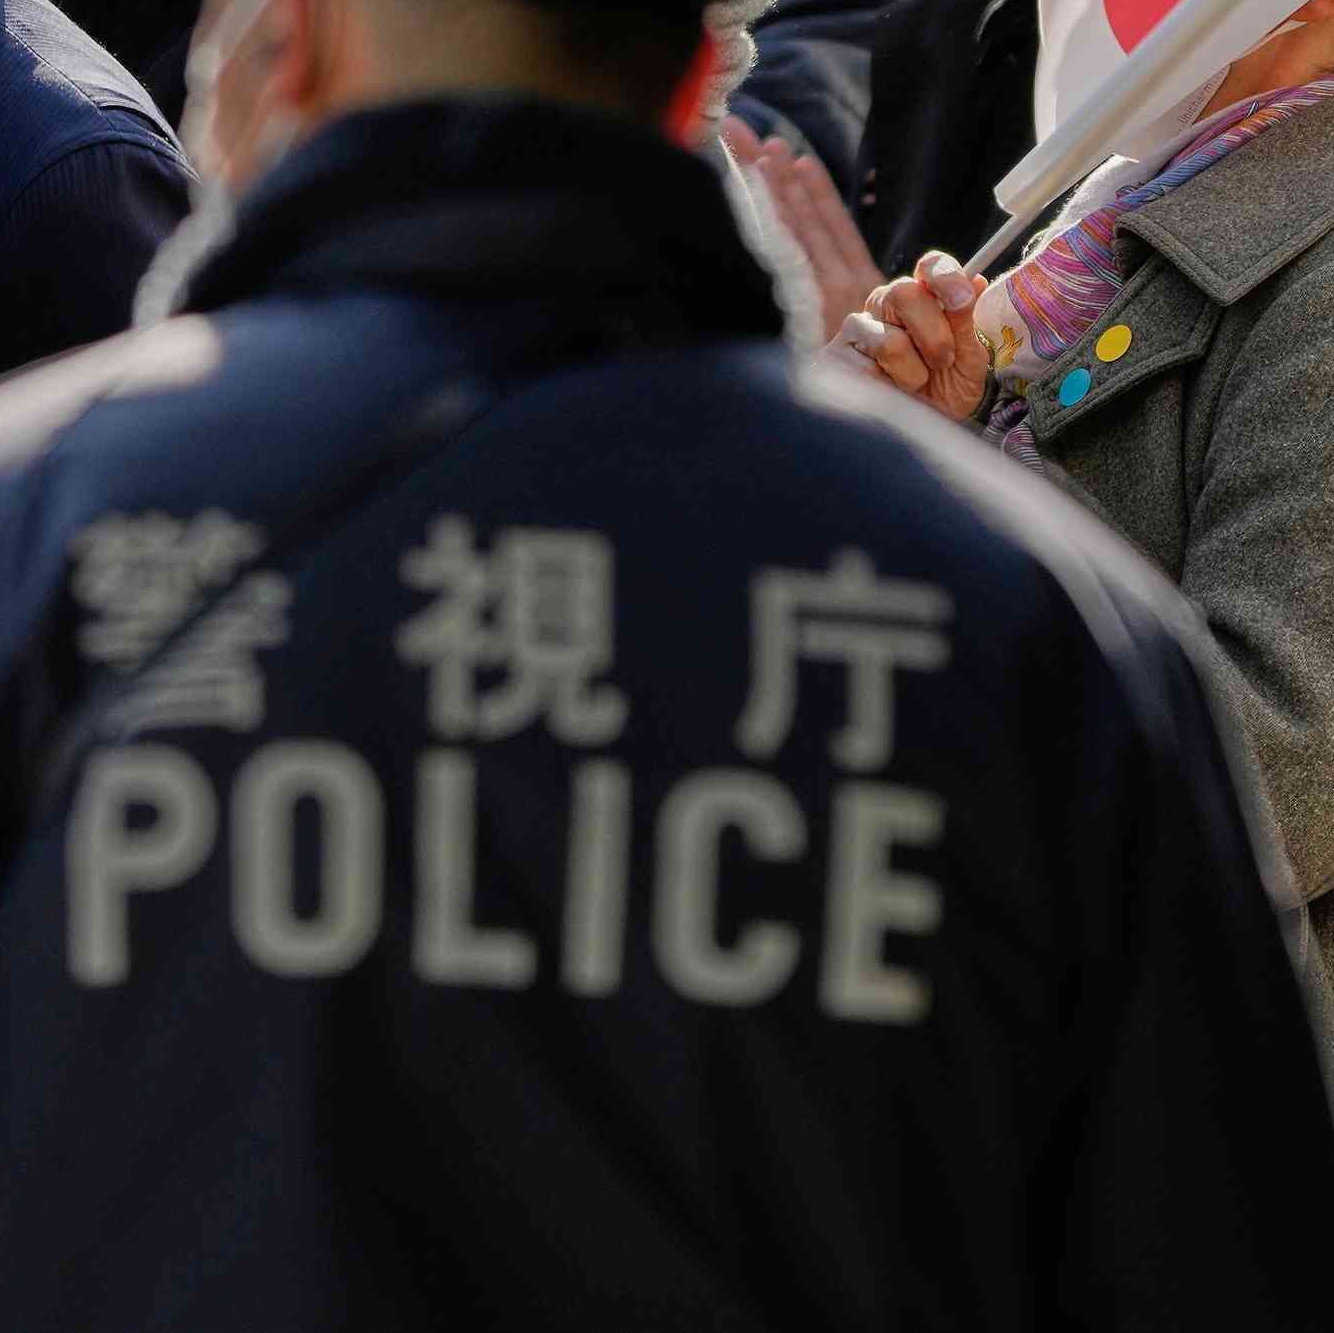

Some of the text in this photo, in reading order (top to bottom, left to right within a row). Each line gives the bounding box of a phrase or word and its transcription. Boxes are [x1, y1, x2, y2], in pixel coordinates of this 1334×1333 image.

[71, 507, 953, 771] 警視庁
[68, 739, 946, 1025] POLICE
